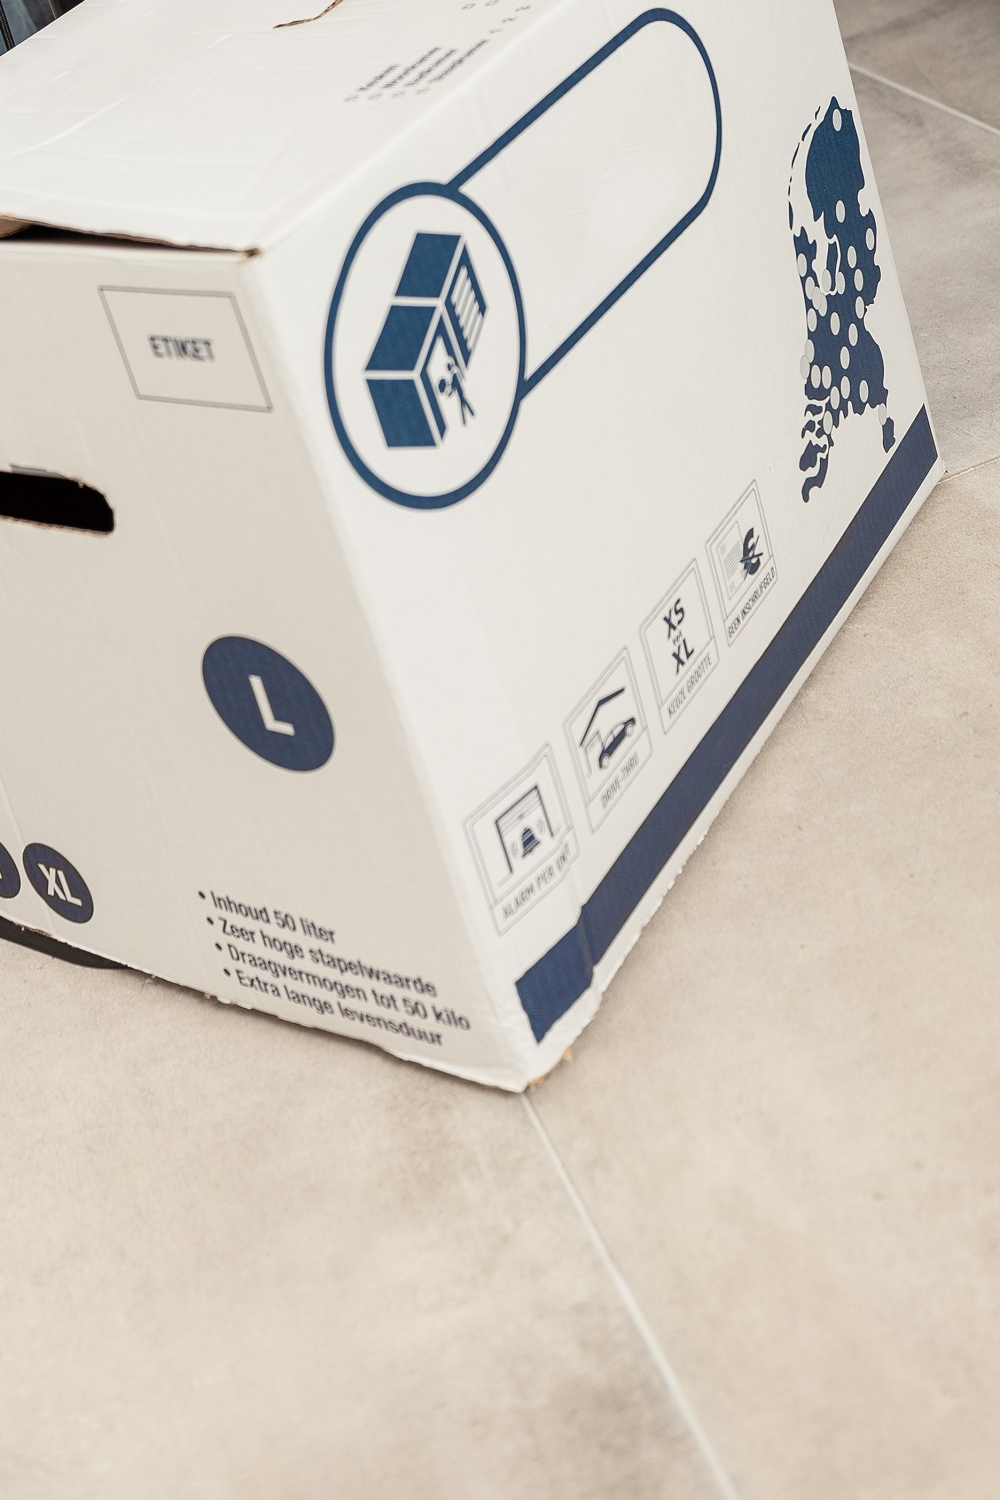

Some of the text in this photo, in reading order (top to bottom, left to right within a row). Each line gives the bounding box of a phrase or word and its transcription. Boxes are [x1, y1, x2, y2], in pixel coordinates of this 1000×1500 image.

[148, 333, 216, 364] ETIKET
[662, 597, 686, 640] XS
[671, 637, 696, 676] XL
[248, 674, 296, 737] L
[37, 862, 83, 908] XL
[210, 890, 336, 945] Inhoud 50 liter
[218, 916, 438, 998] Zeer hoge stapelwaarde
[226, 943, 471, 1032] Draagvermogen tot 50 kilo
[234, 968, 443, 1047] Extra lange levensduur
